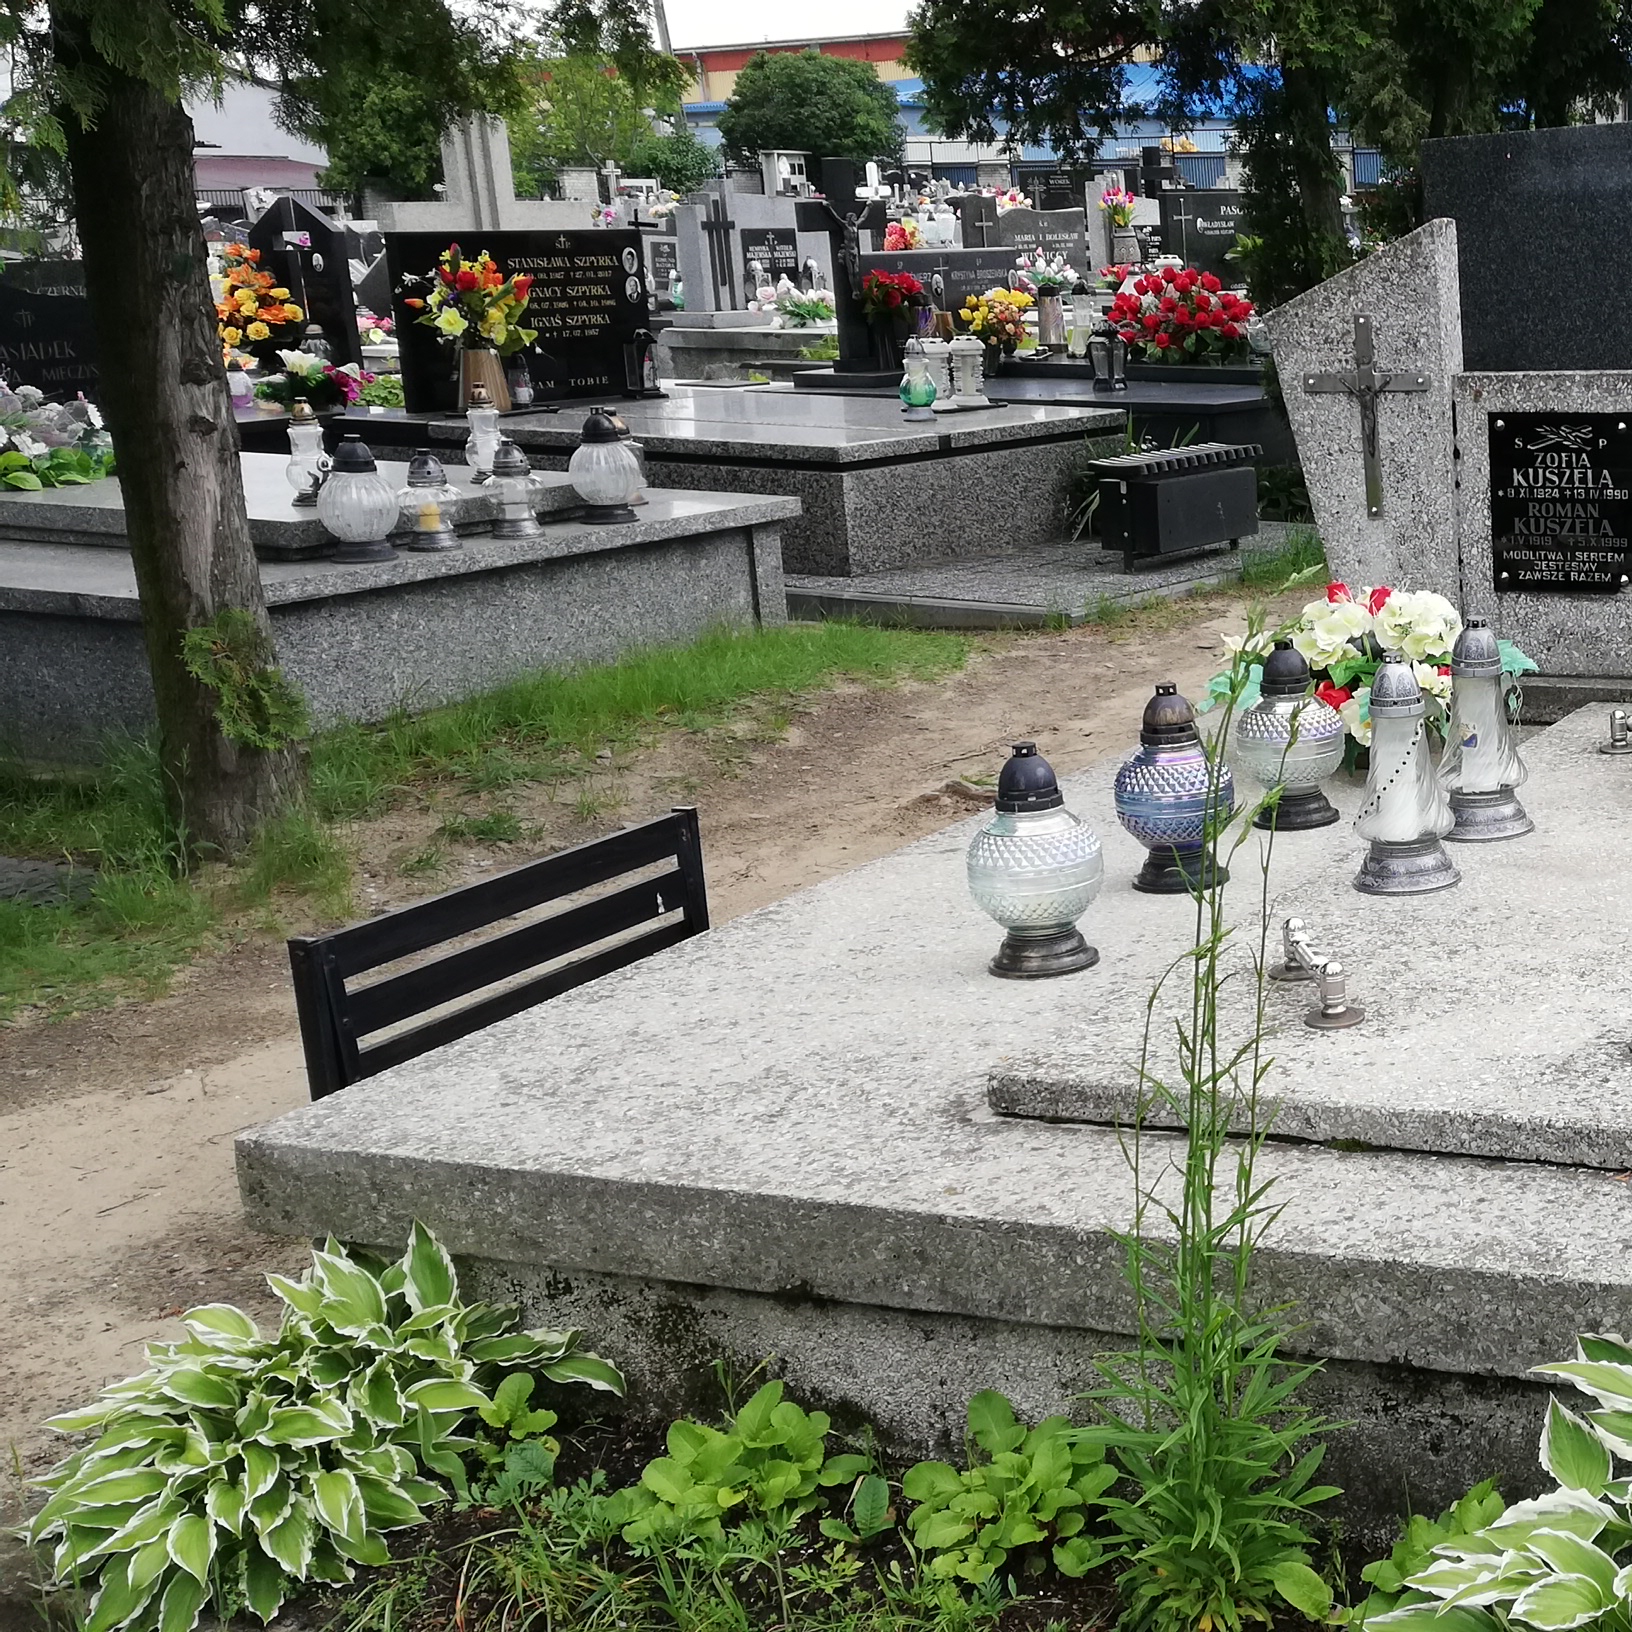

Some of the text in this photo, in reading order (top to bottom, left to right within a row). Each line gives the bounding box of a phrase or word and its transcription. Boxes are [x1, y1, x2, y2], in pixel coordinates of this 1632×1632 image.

[507, 255, 620, 270] STANISŁAWA SZPYRKA
[527, 284, 612, 298] GNACY SZPYRKA
[565, 313, 612, 326] SZPYRKA
[568, 375, 610, 387] TOBIE
[1534, 452, 1591, 468] ZOFIA
[1512, 467, 1614, 488] KUSZELA
[1528, 502, 1599, 518] ROMAN
[1514, 517, 1614, 536] KUSZELA
[1503, 550, 1625, 563] MODLITWA I SERCEM
[1518, 570, 1612, 583] ZAWSZE RAZEM
